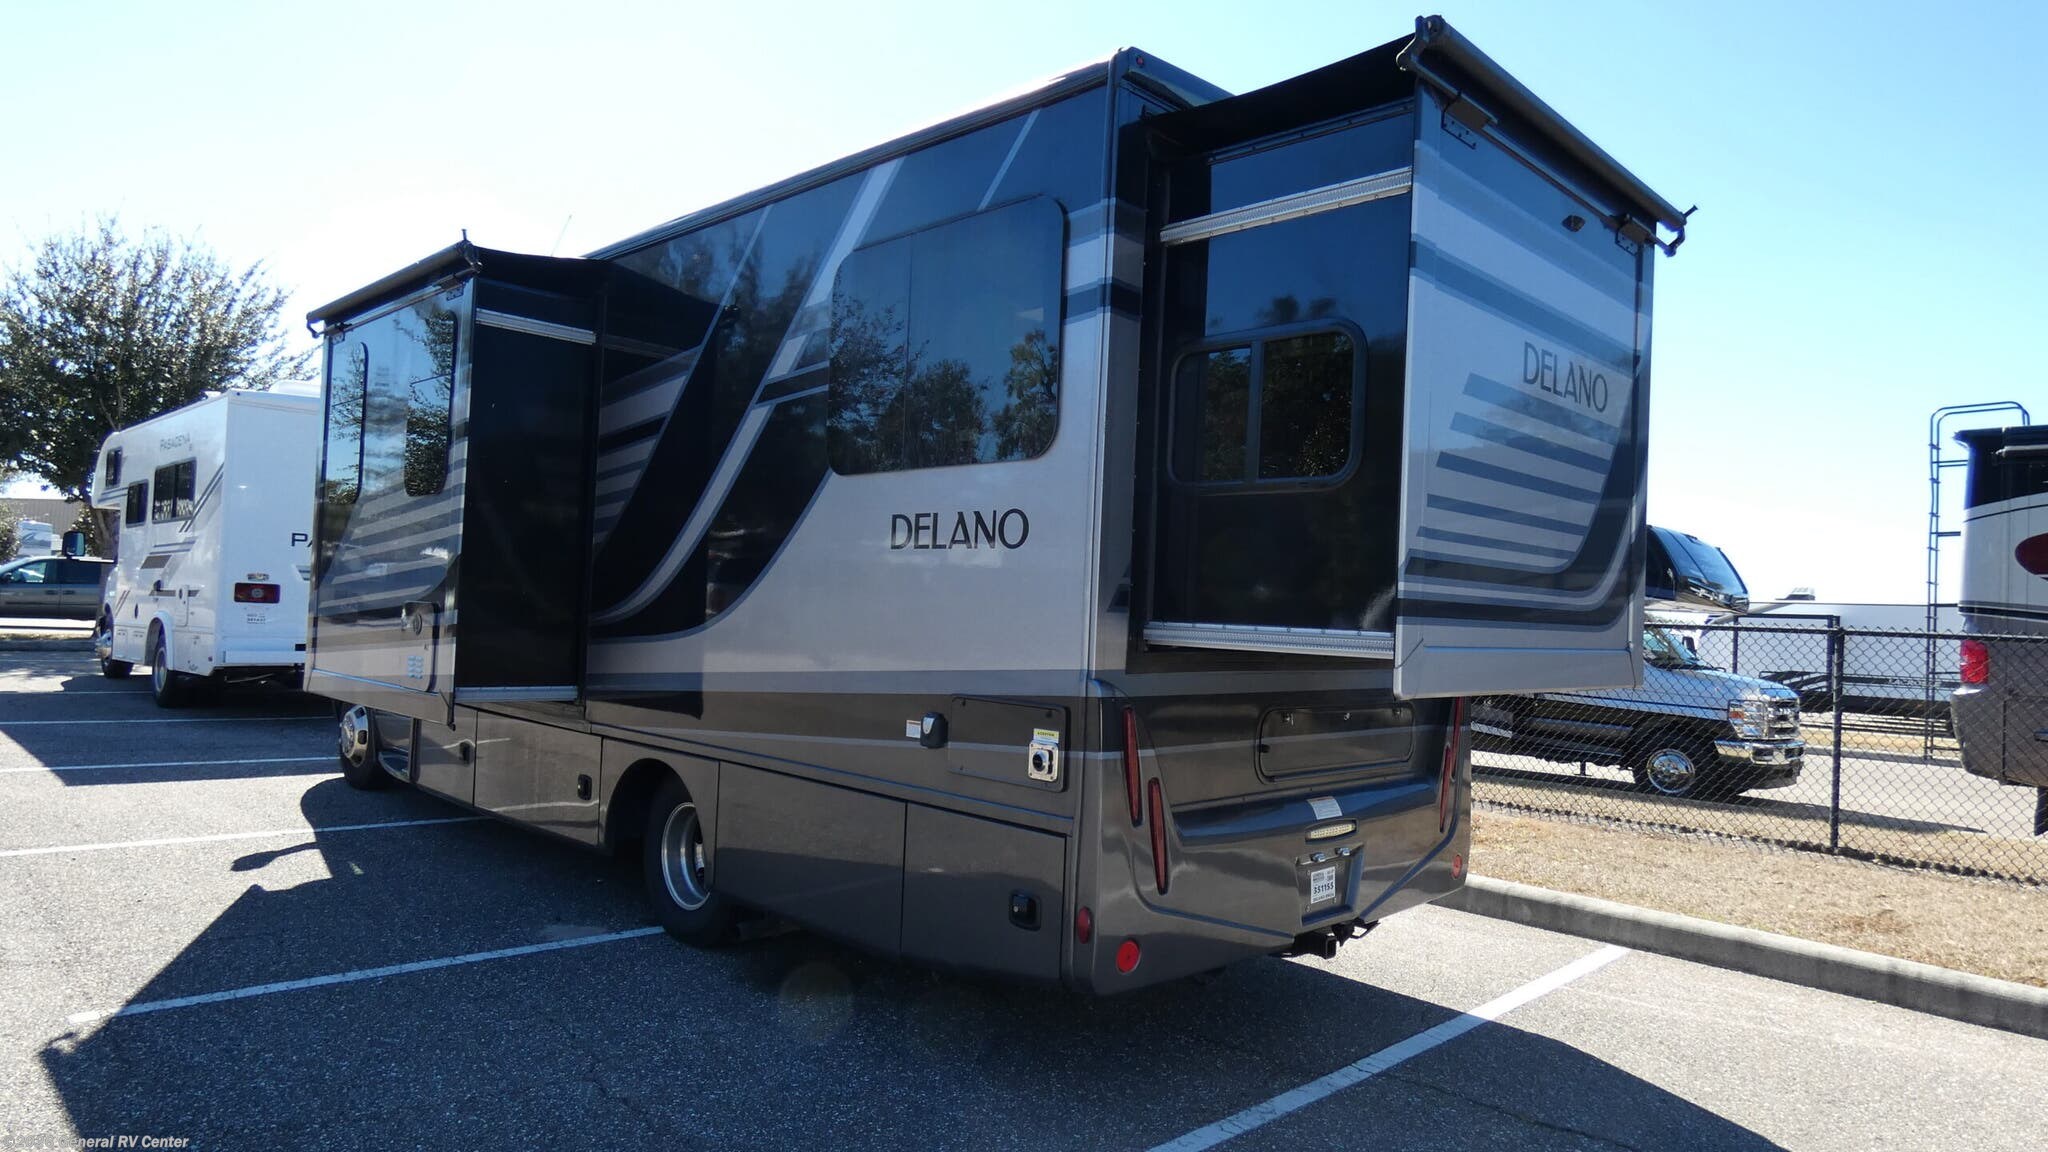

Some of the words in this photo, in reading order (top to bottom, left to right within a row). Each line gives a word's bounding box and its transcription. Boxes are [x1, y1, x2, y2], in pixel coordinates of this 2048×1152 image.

[1523, 341, 1608, 412] DELANO
[291, 532, 313, 548] P
[890, 508, 1030, 550] DELANO
